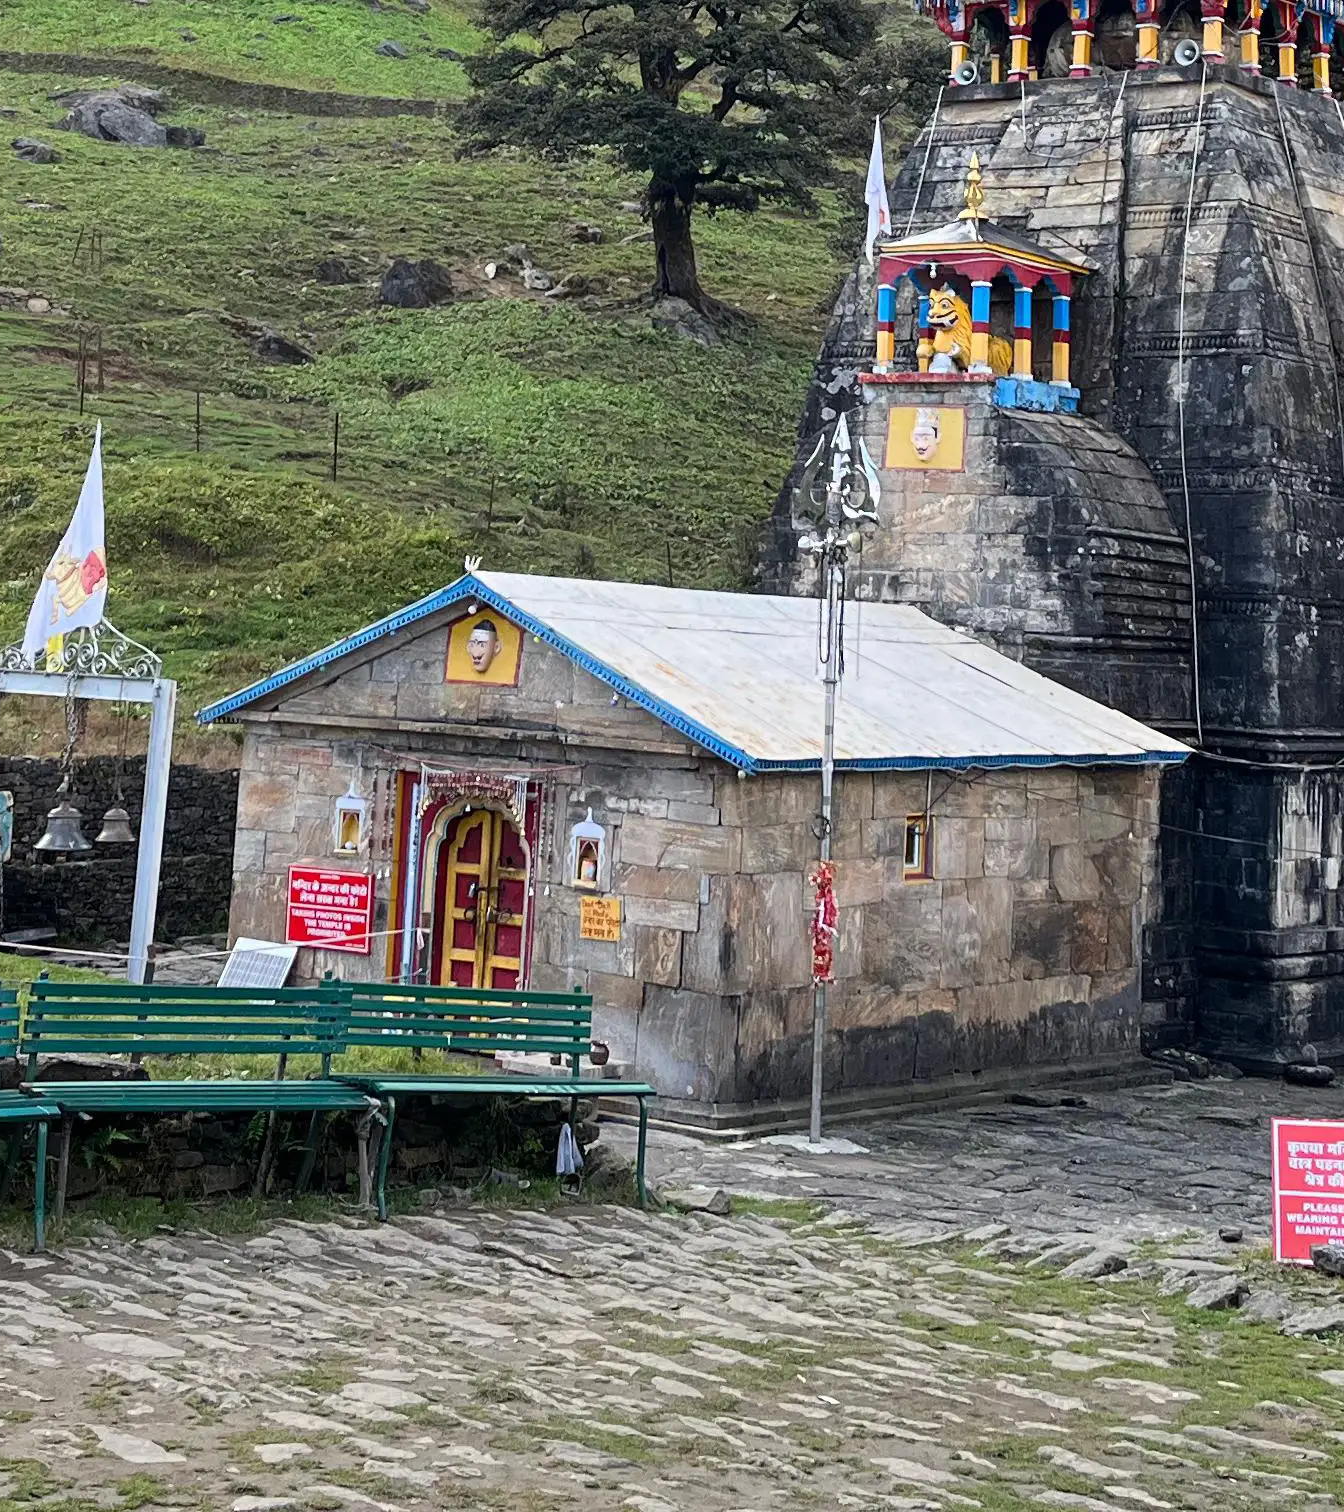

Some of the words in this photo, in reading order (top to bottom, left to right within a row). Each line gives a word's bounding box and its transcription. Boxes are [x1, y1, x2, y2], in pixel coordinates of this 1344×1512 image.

[316, 910, 343, 921] PHOTOS
[304, 918, 317, 928] THE
[318, 919, 343, 930] TEMPLE
[343, 922, 351, 931] IS
[1286, 1213, 1338, 1225] WEARING
